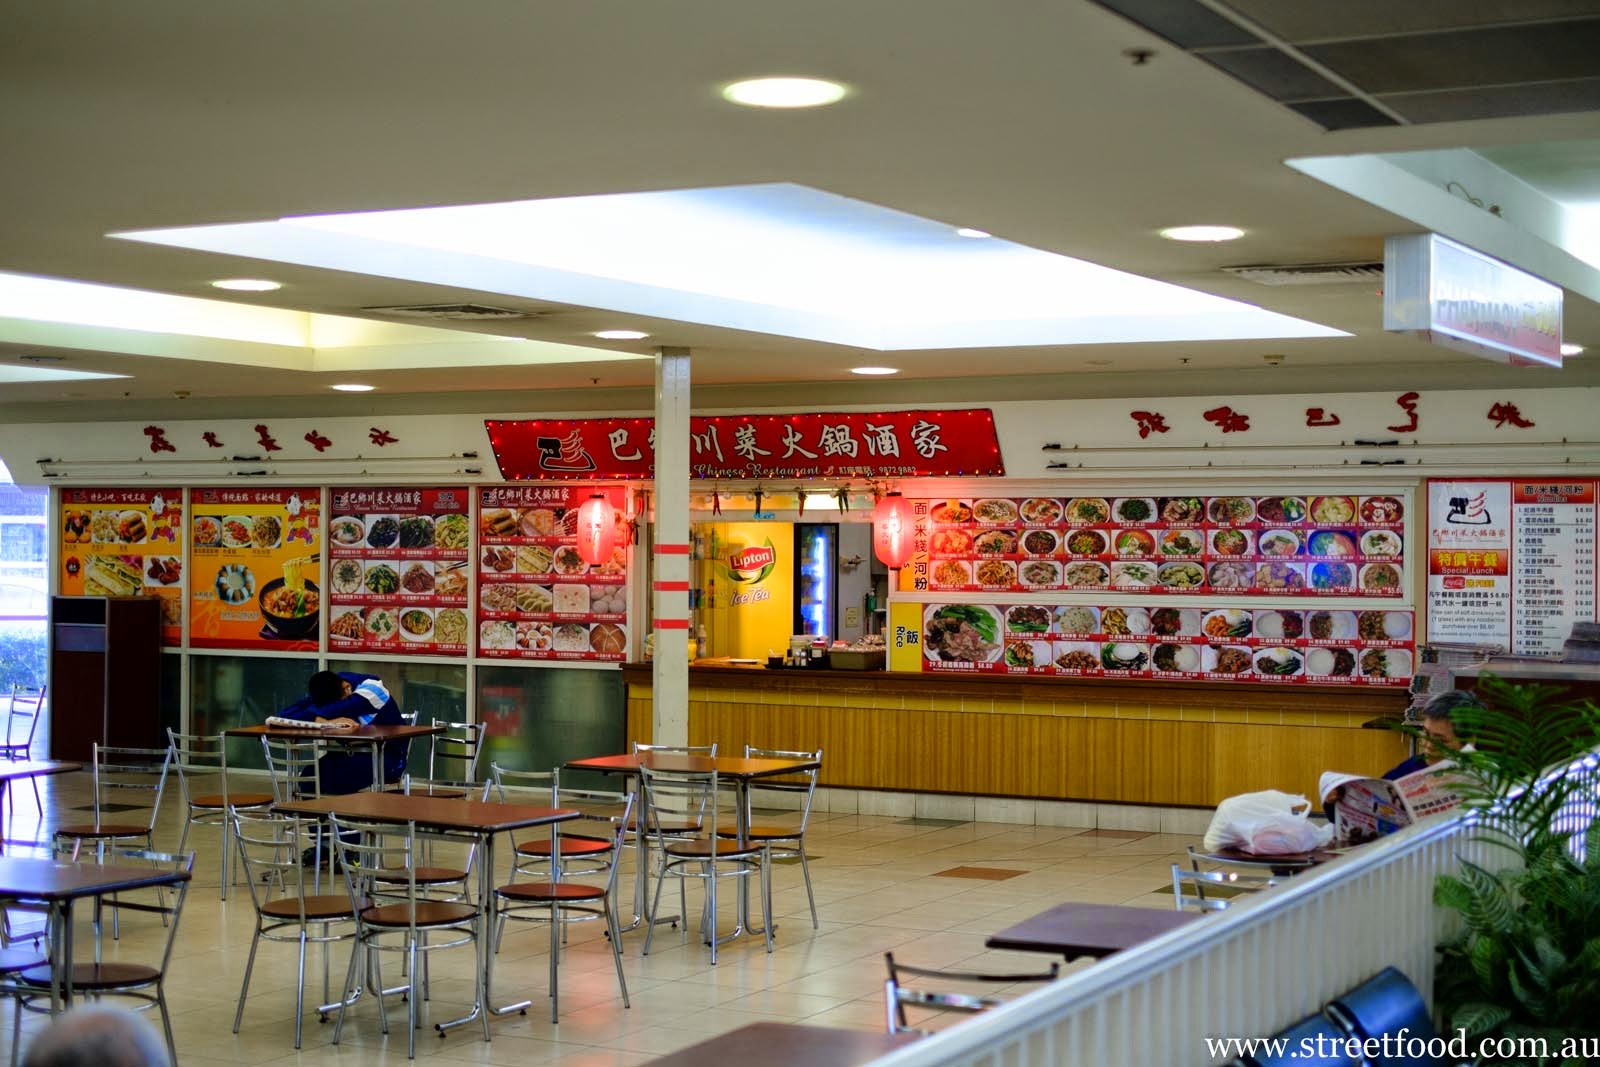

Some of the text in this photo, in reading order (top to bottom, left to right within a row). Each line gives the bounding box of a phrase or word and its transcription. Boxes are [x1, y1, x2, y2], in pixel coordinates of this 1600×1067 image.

[608, 420, 948, 463] 巴川菜火鍋酒家
[693, 463, 820, 475] Chinese Restaurant
[733, 551, 770, 567] Lipton
[1442, 567, 1468, 575] Special
[730, 587, 769, 606] Ice Tea
[896, 626, 905, 648] Rice
